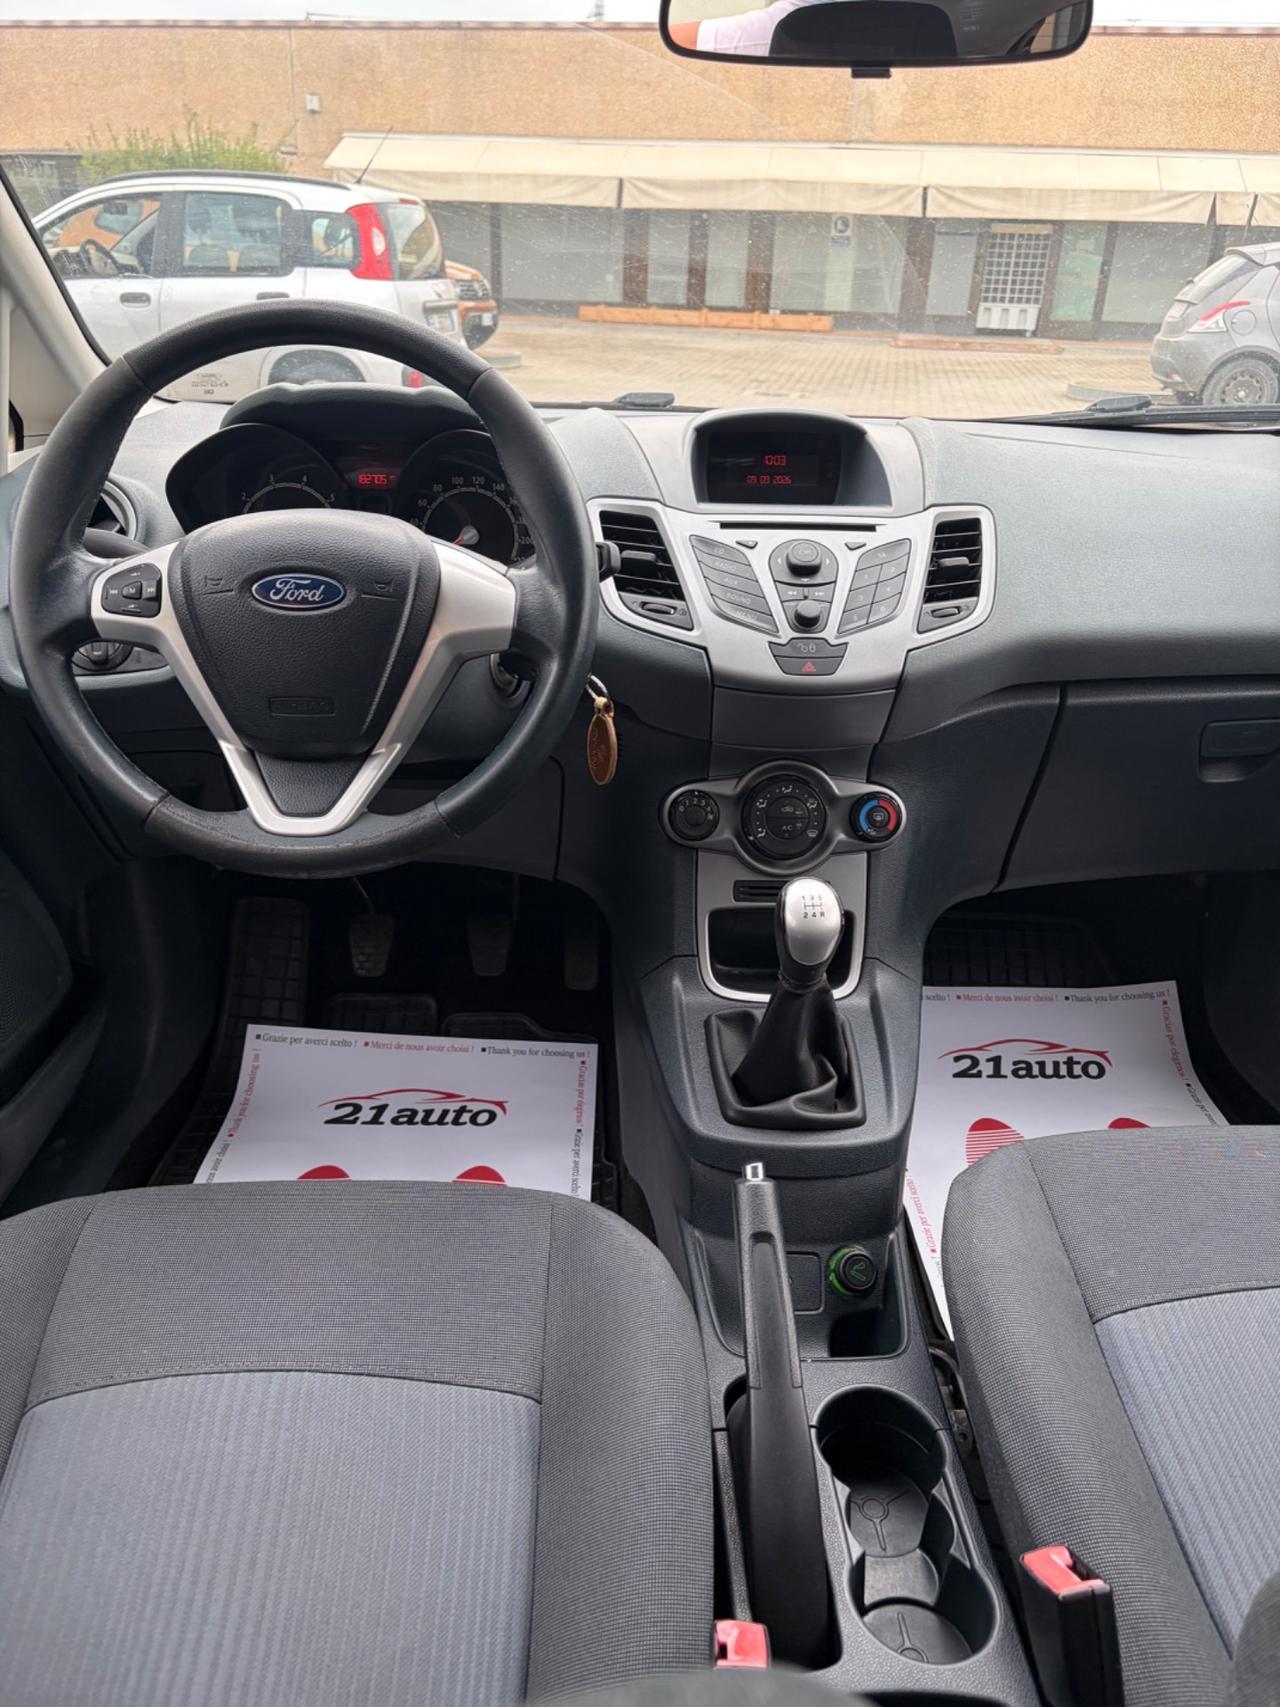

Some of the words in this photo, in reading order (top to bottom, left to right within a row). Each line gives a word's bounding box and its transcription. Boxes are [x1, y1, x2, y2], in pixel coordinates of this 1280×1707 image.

[472, 476, 484, 486] 120
[269, 578, 324, 602] Ford
[262, 1033, 288, 1043] Grazie
[290, 1036, 302, 1045] per
[304, 1037, 328, 1046] averci
[330, 1038, 352, 1048] scelto
[370, 1040, 392, 1050] Merci
[394, 1041, 404, 1050] de
[426, 1044, 445, 1052] avoir
[446, 1044, 470, 1053] choisi
[487, 1046, 510, 1055] Thank
[512, 1049, 526, 1057] you
[528, 1048, 540, 1056] for
[541, 1049, 575, 1059] choosing
[952, 1054, 1106, 1080] 21auto
[324, 1102, 497, 1127] 21auto
